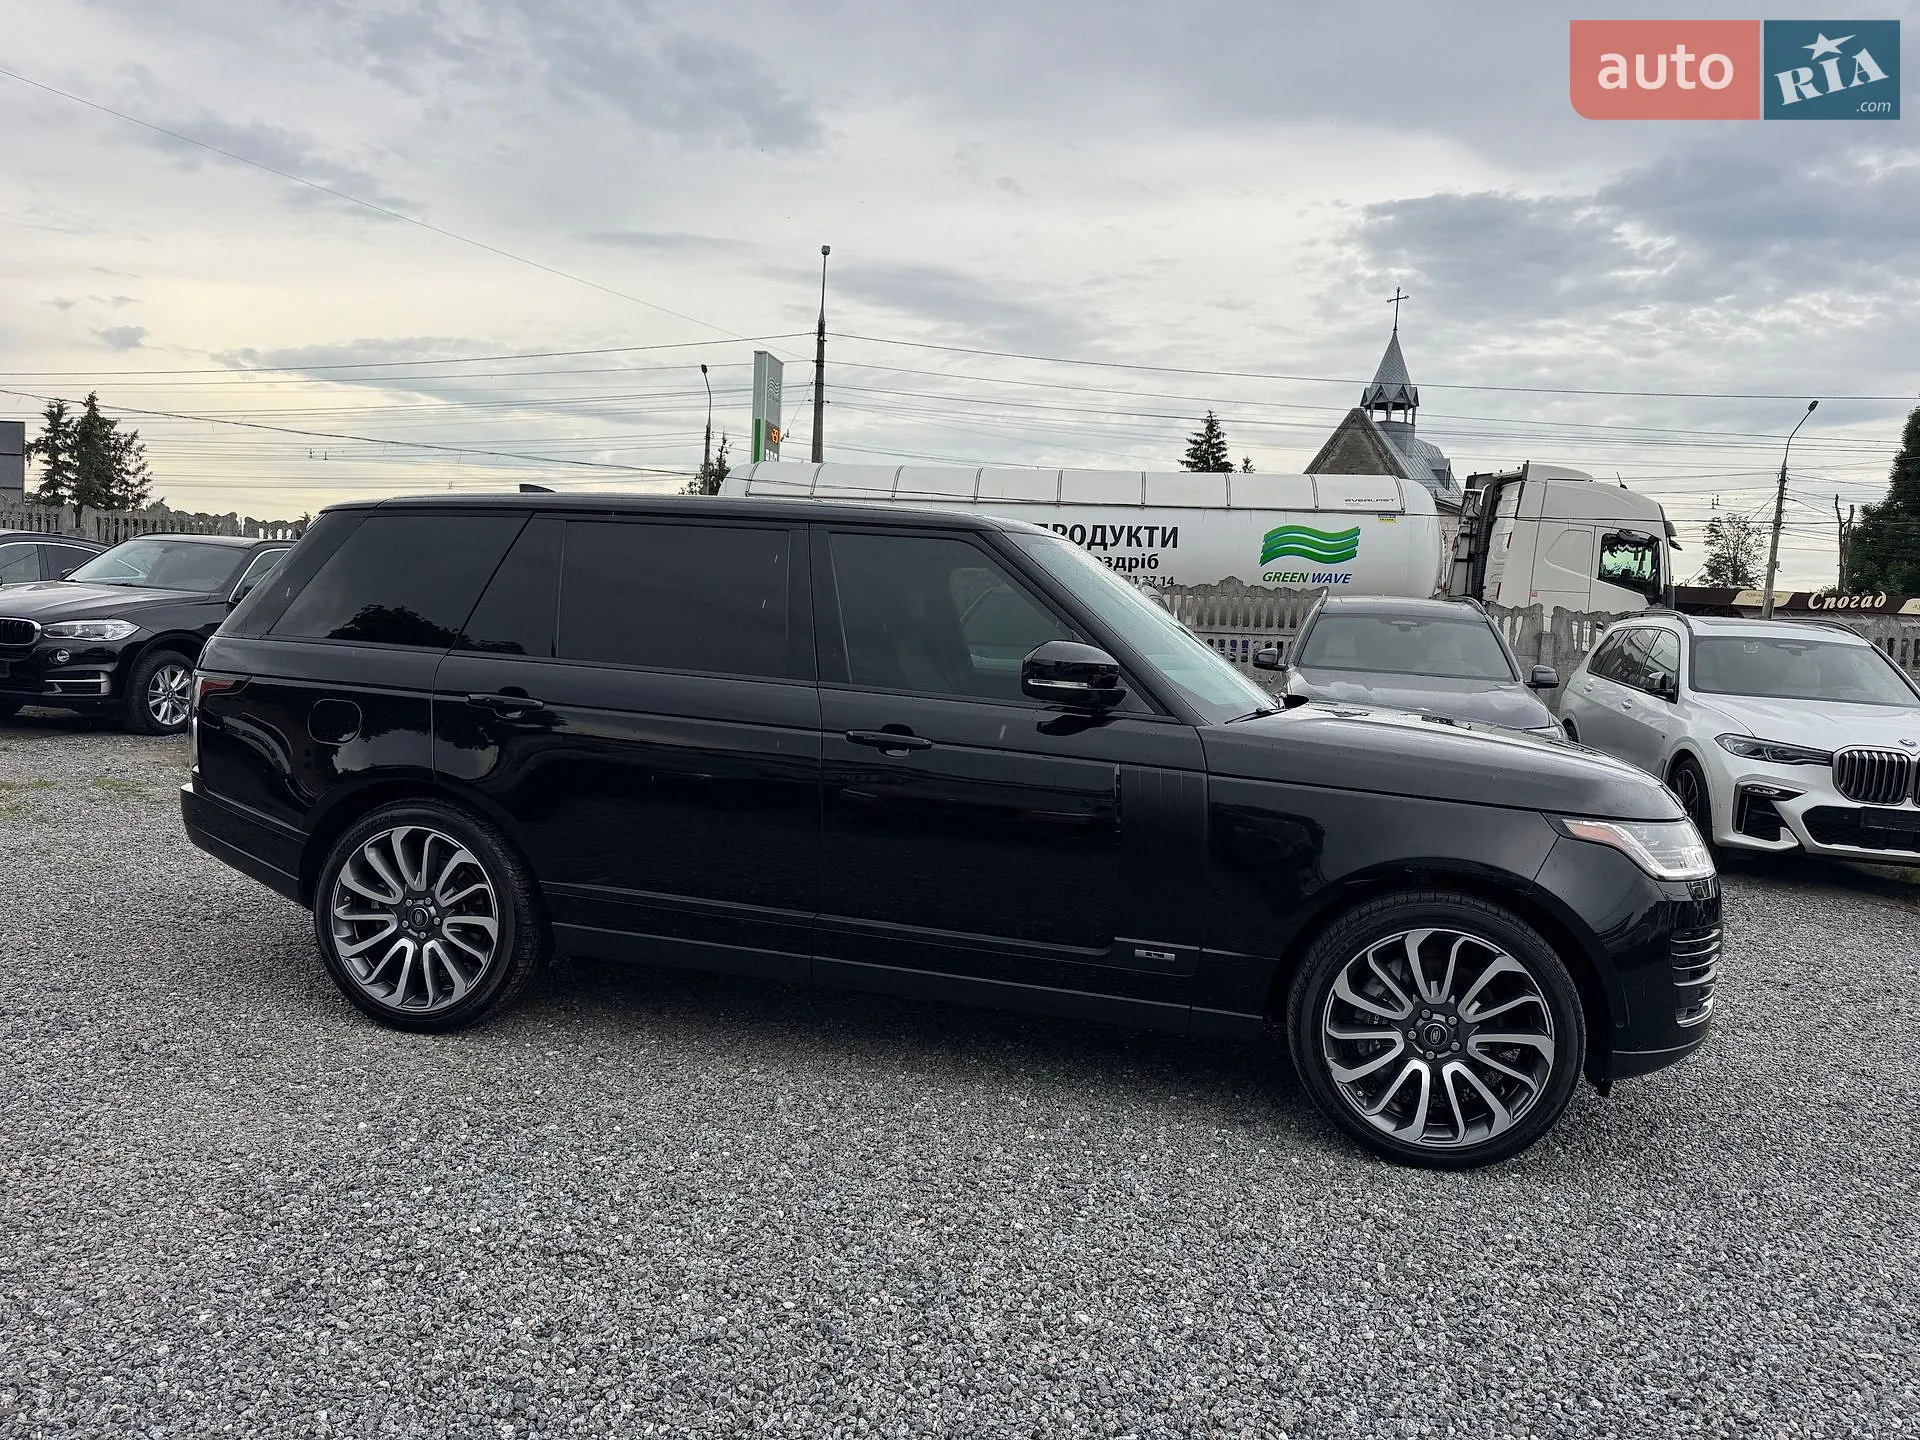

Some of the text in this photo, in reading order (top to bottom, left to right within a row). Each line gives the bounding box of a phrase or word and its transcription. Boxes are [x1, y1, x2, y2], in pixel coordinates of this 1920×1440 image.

[1160, 575, 1175, 587] 14
[1262, 571, 1353, 584] GREEN WAVE
[1806, 590, 1888, 610] Спогад
